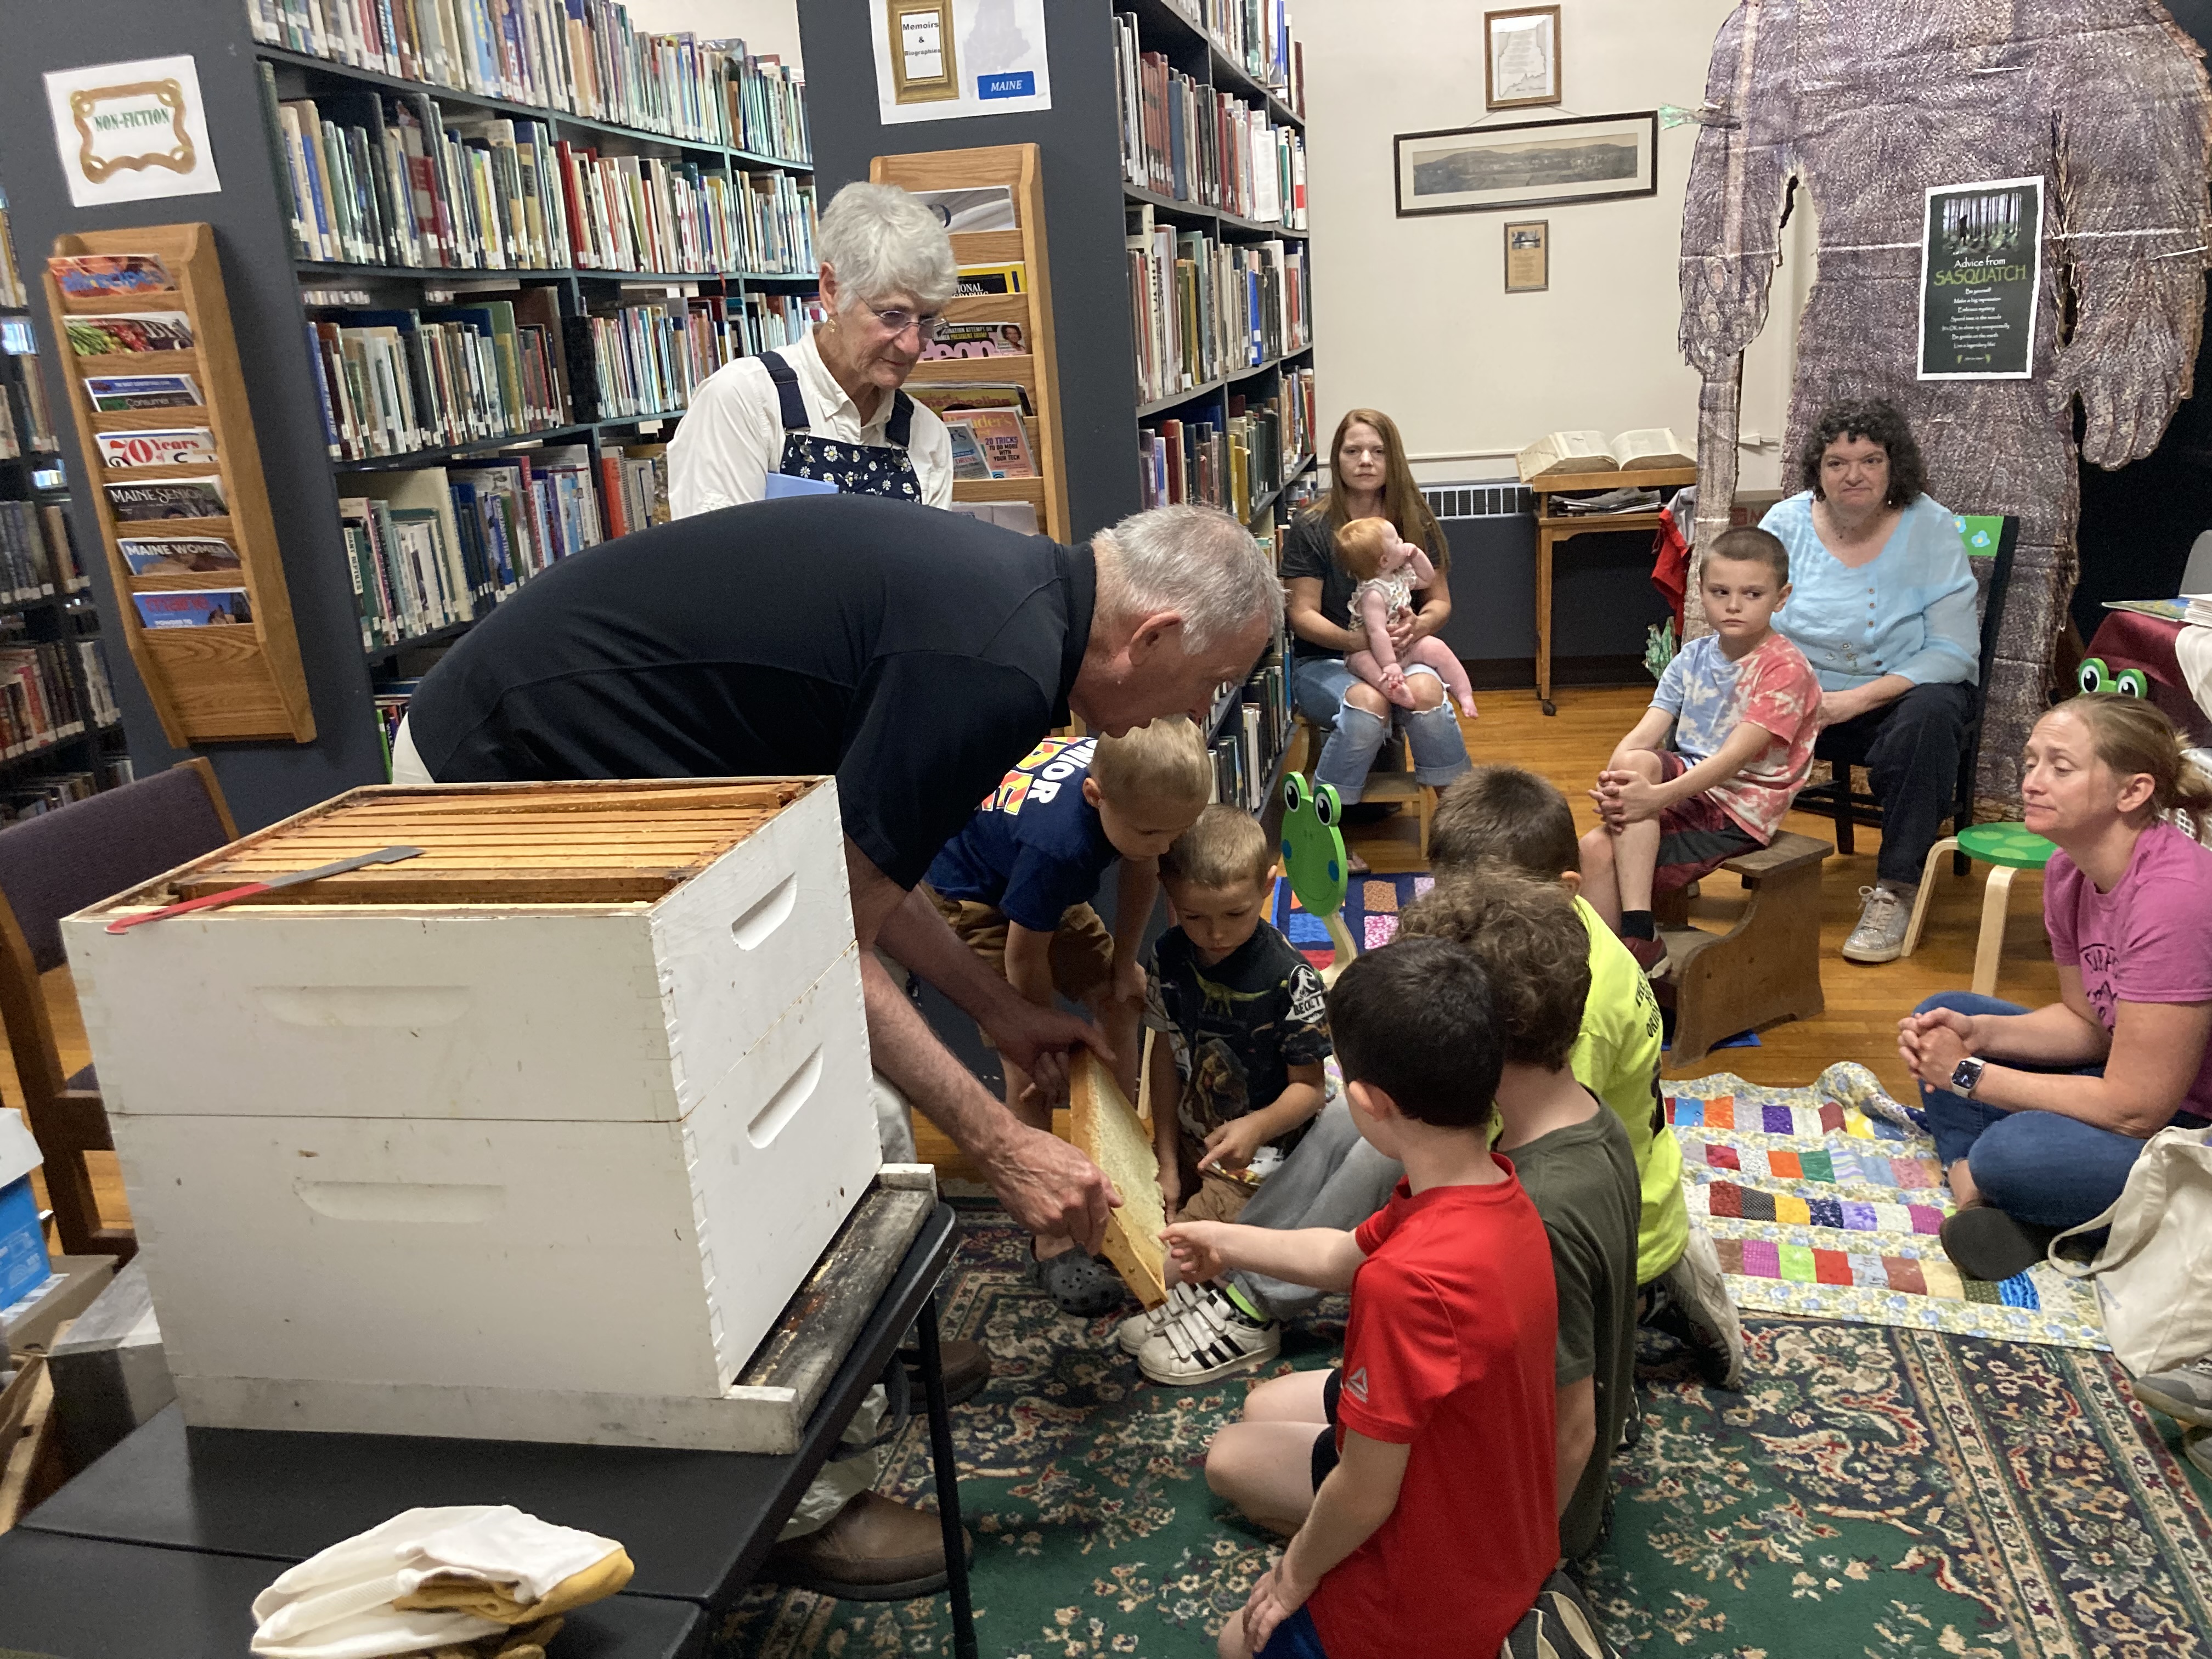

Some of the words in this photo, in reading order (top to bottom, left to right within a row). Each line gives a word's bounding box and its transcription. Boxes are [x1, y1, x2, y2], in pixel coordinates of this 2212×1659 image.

[902, 21, 939, 31] Memoirs
[904, 48, 941, 57] Biographies
[991, 80, 1023, 92] MAINE
[94, 108, 170, 131] NON-FICTION
[1954, 257, 1984, 268] Advice
[1986, 255, 2006, 266] from
[1933, 264, 2027, 286] SASQUATCH
[151, 439, 200, 450] Years
[995, 436, 1018, 444] TRICKS
[110, 489, 157, 503] MAINE
[126, 545, 173, 556] MAINE
[171, 544, 228, 555] WOMEN
